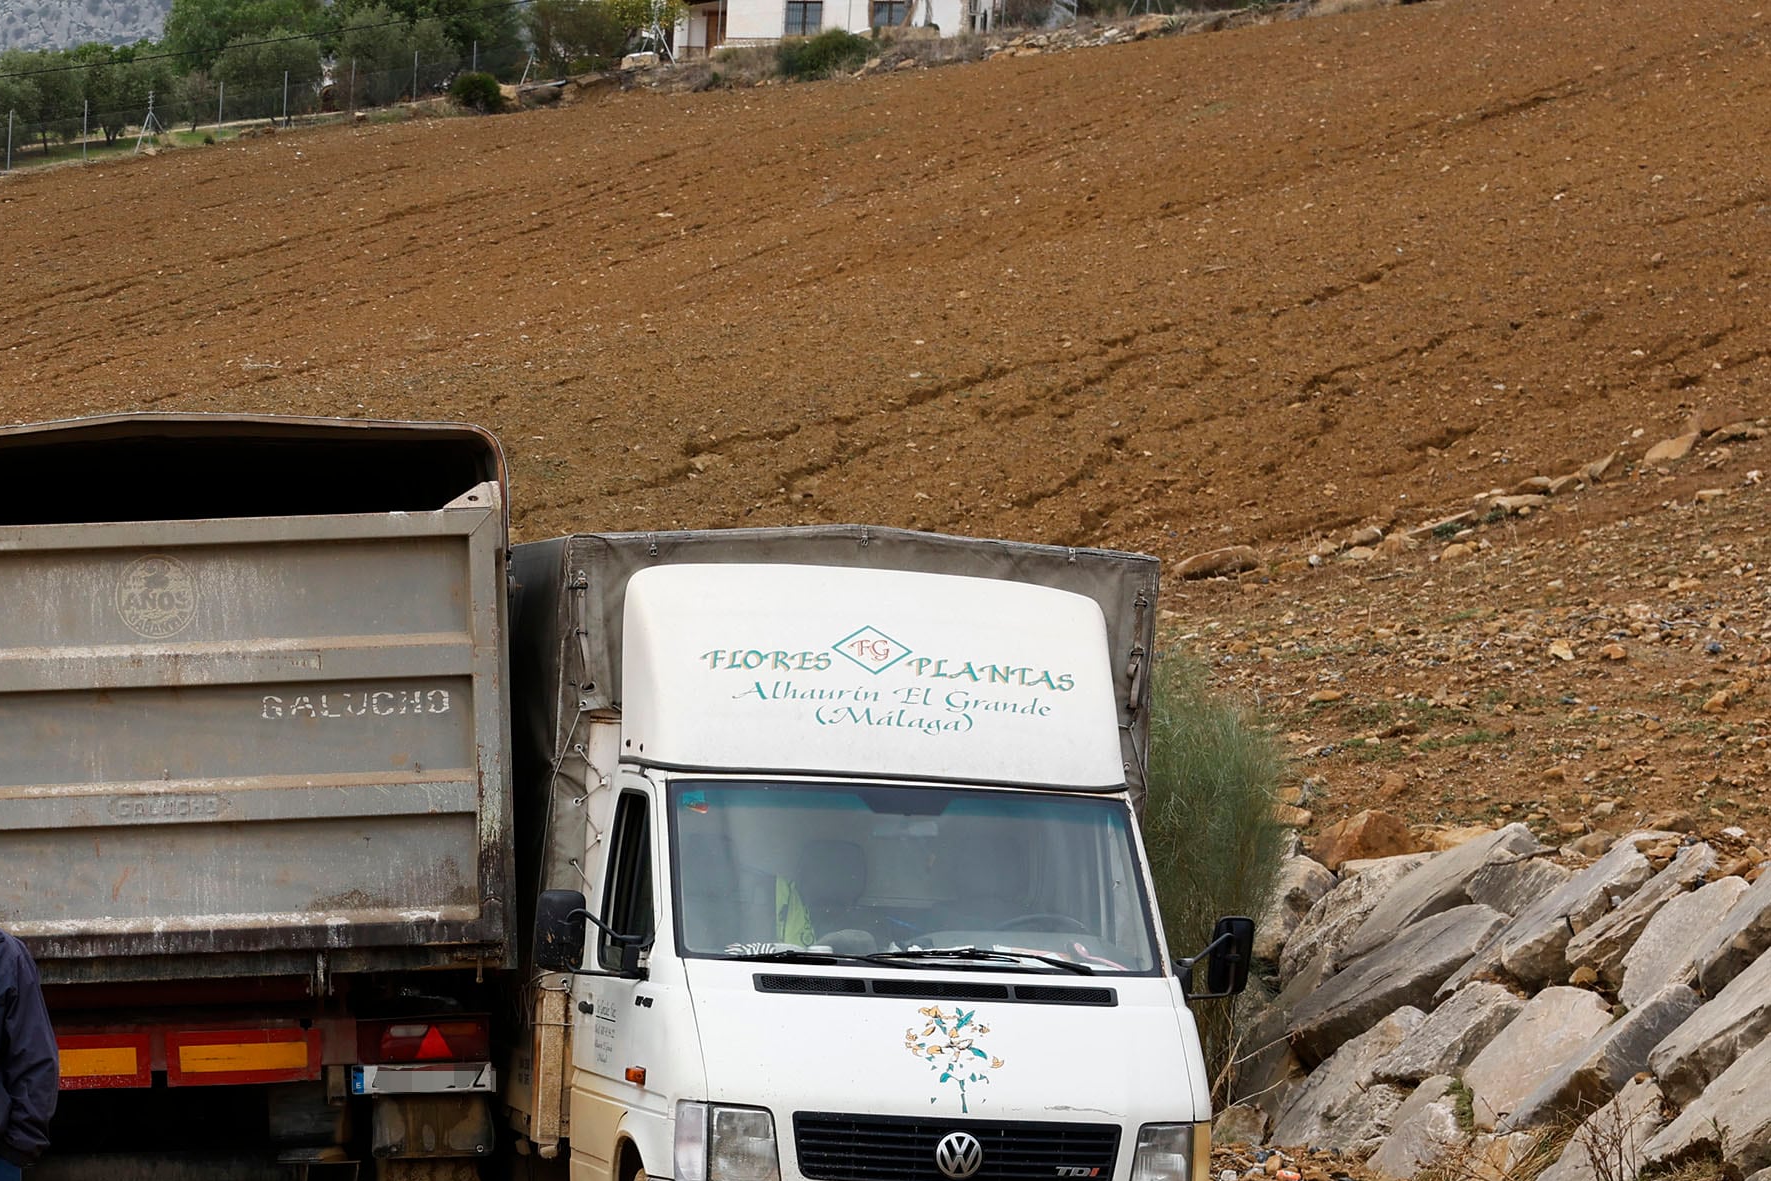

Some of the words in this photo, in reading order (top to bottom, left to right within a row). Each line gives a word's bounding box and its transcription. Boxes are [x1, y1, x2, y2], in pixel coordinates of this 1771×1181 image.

[848, 639, 891, 662] FG
[700, 649, 832, 672] FLORES
[905, 657, 1076, 692] PLANTAS
[260, 689, 450, 720] GALUCHO
[893, 687, 932, 706] El
[945, 690, 1052, 717] Grande
[815, 704, 974, 737] (Málaga)
[1054, 1166, 1101, 1178] TDI
